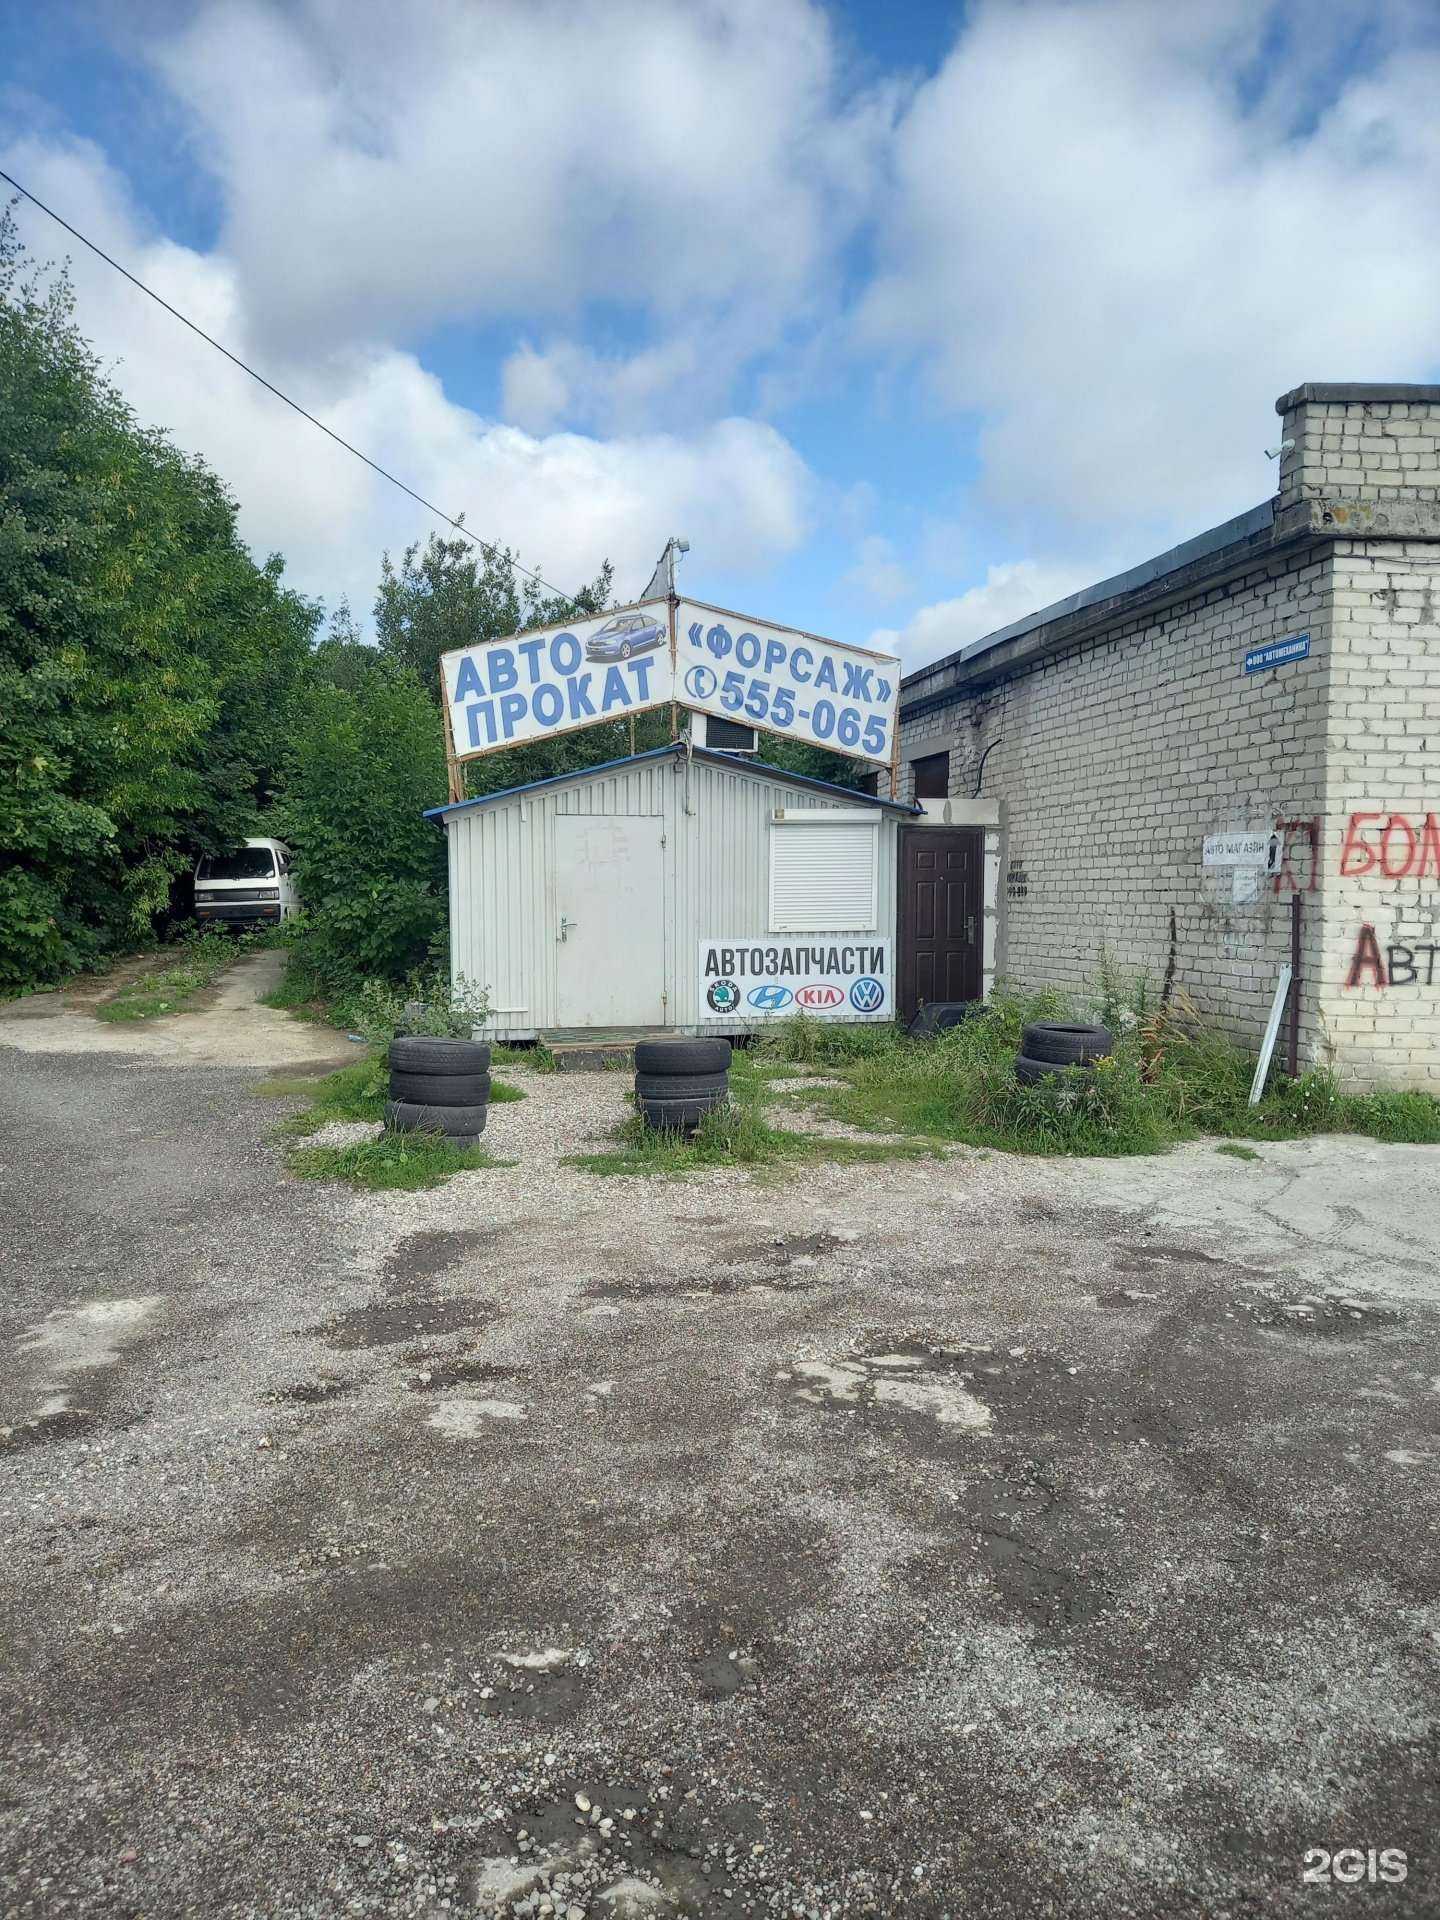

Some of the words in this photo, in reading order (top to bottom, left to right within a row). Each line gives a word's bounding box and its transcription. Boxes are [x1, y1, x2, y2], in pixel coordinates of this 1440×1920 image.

[454, 632, 582, 703] АВТО
[687, 621, 892, 704] «ФОРСАЖ»
[466, 656, 655, 748] ПРОКАТ
[719, 671, 888, 756] 555-065
[705, 947, 884, 976] АВТОЗАПЧАСТИ
[803, 990, 836, 1004] KIA
